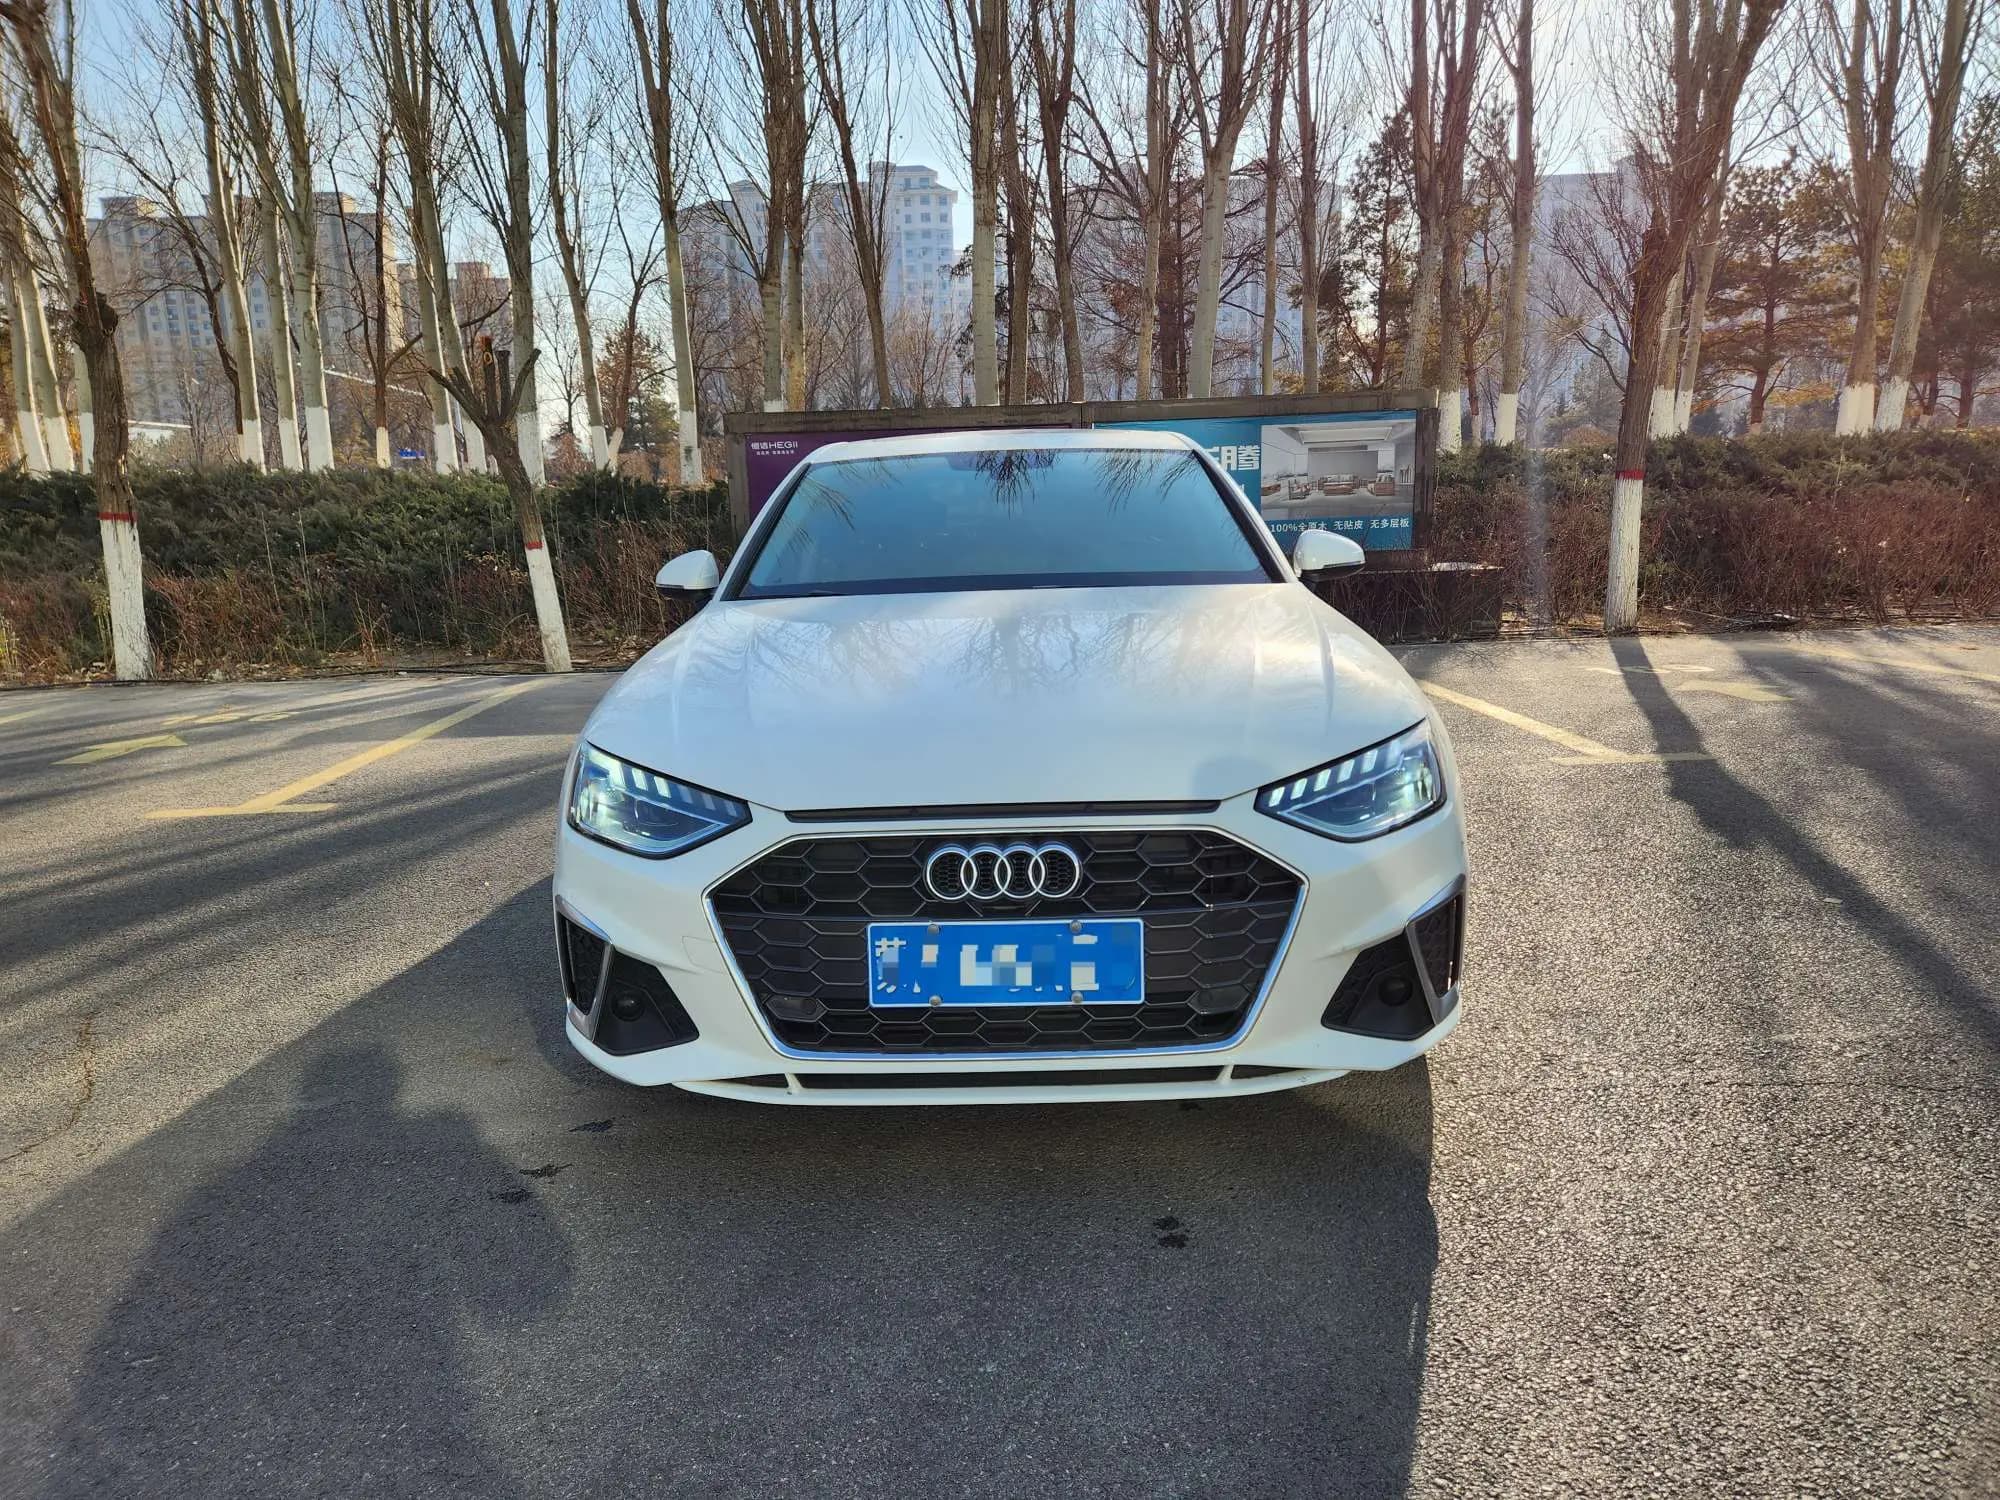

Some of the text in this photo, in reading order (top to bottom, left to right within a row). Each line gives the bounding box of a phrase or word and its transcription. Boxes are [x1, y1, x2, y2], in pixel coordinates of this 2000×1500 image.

[1334, 520, 1363, 531] 无贴皮
[1370, 518, 1410, 529] 无多层板
